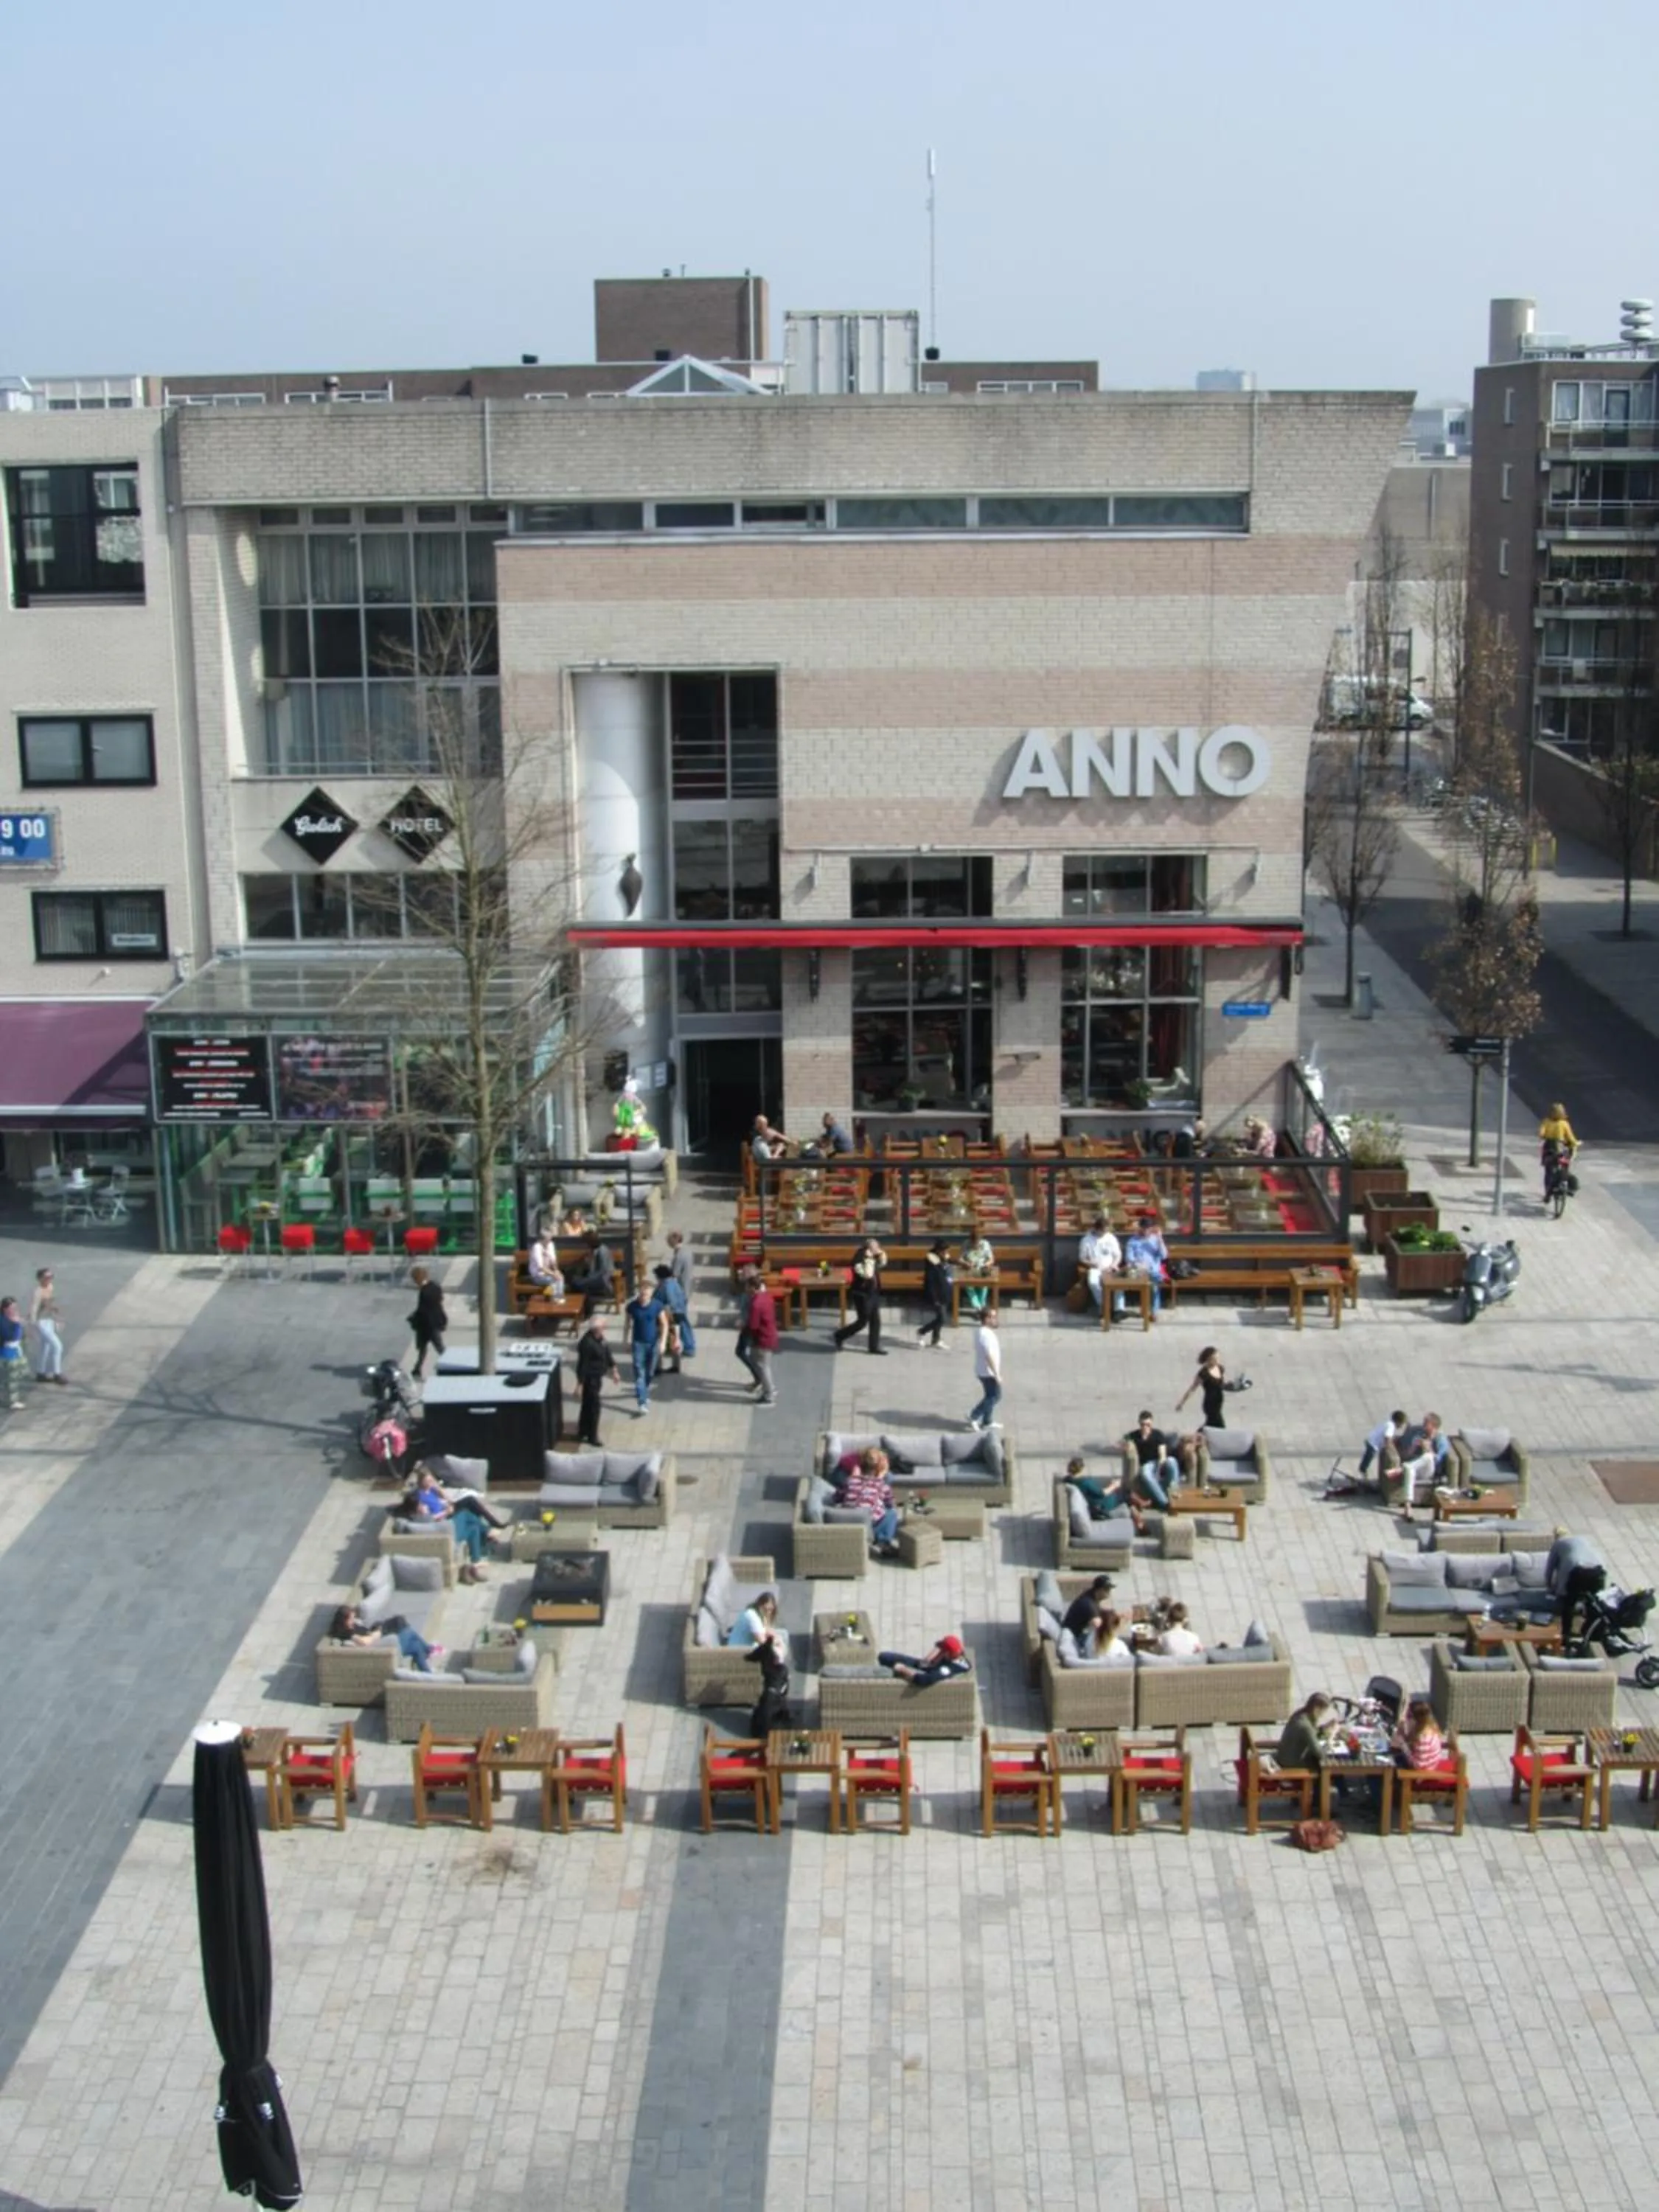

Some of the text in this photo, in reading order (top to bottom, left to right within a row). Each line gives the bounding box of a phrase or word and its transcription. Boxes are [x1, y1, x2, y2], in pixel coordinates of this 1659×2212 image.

[1002, 725, 1273, 798] ANNO
[19, 818, 46, 838] 00
[390, 817, 444, 832] HOTEL
